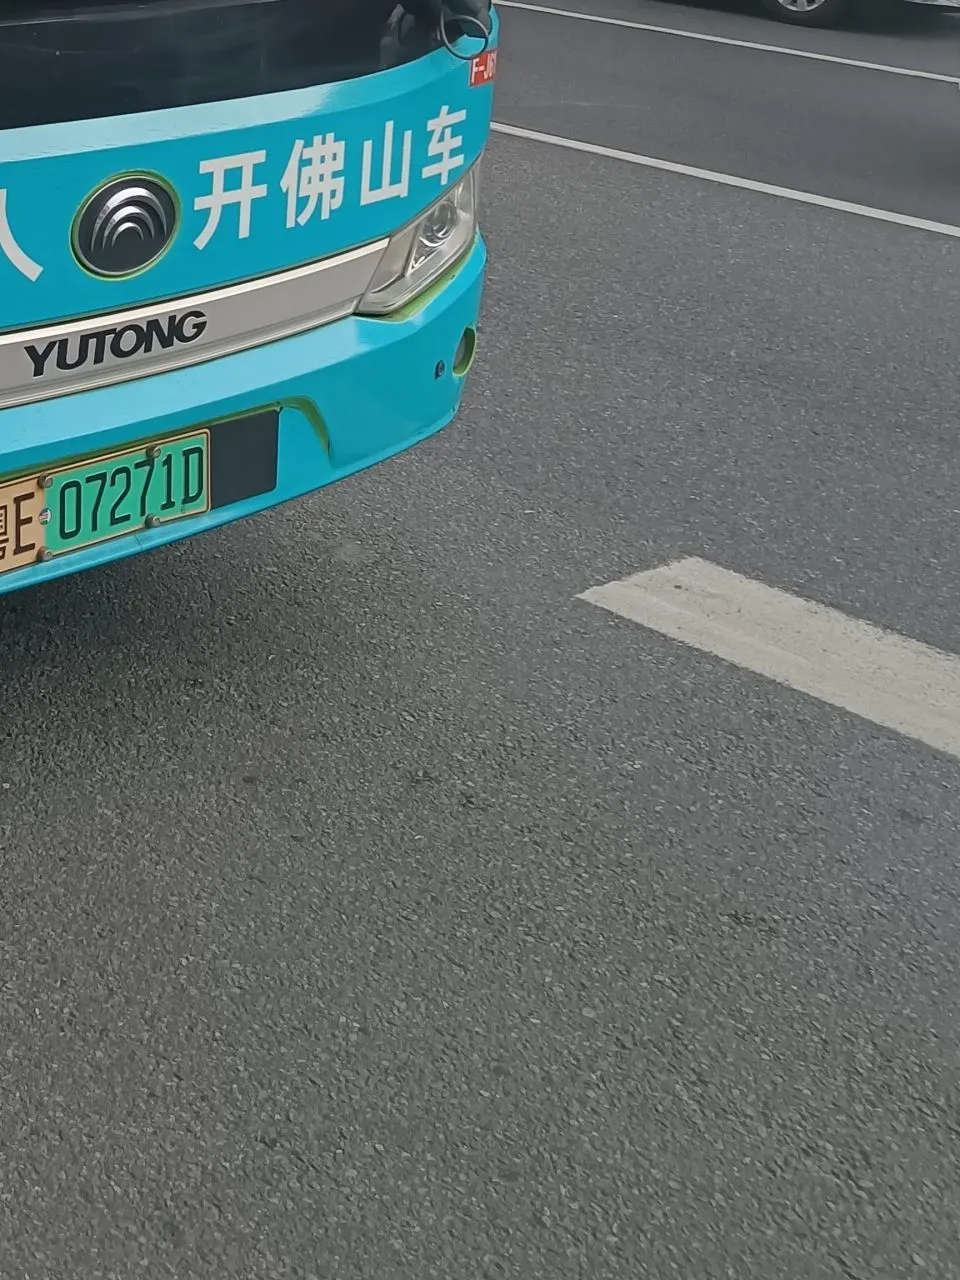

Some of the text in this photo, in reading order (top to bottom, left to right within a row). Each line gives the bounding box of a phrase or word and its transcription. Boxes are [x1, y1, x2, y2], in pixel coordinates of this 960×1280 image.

[193, 104, 467, 252] 开佛山车
[24, 310, 208, 378] YUTONG
